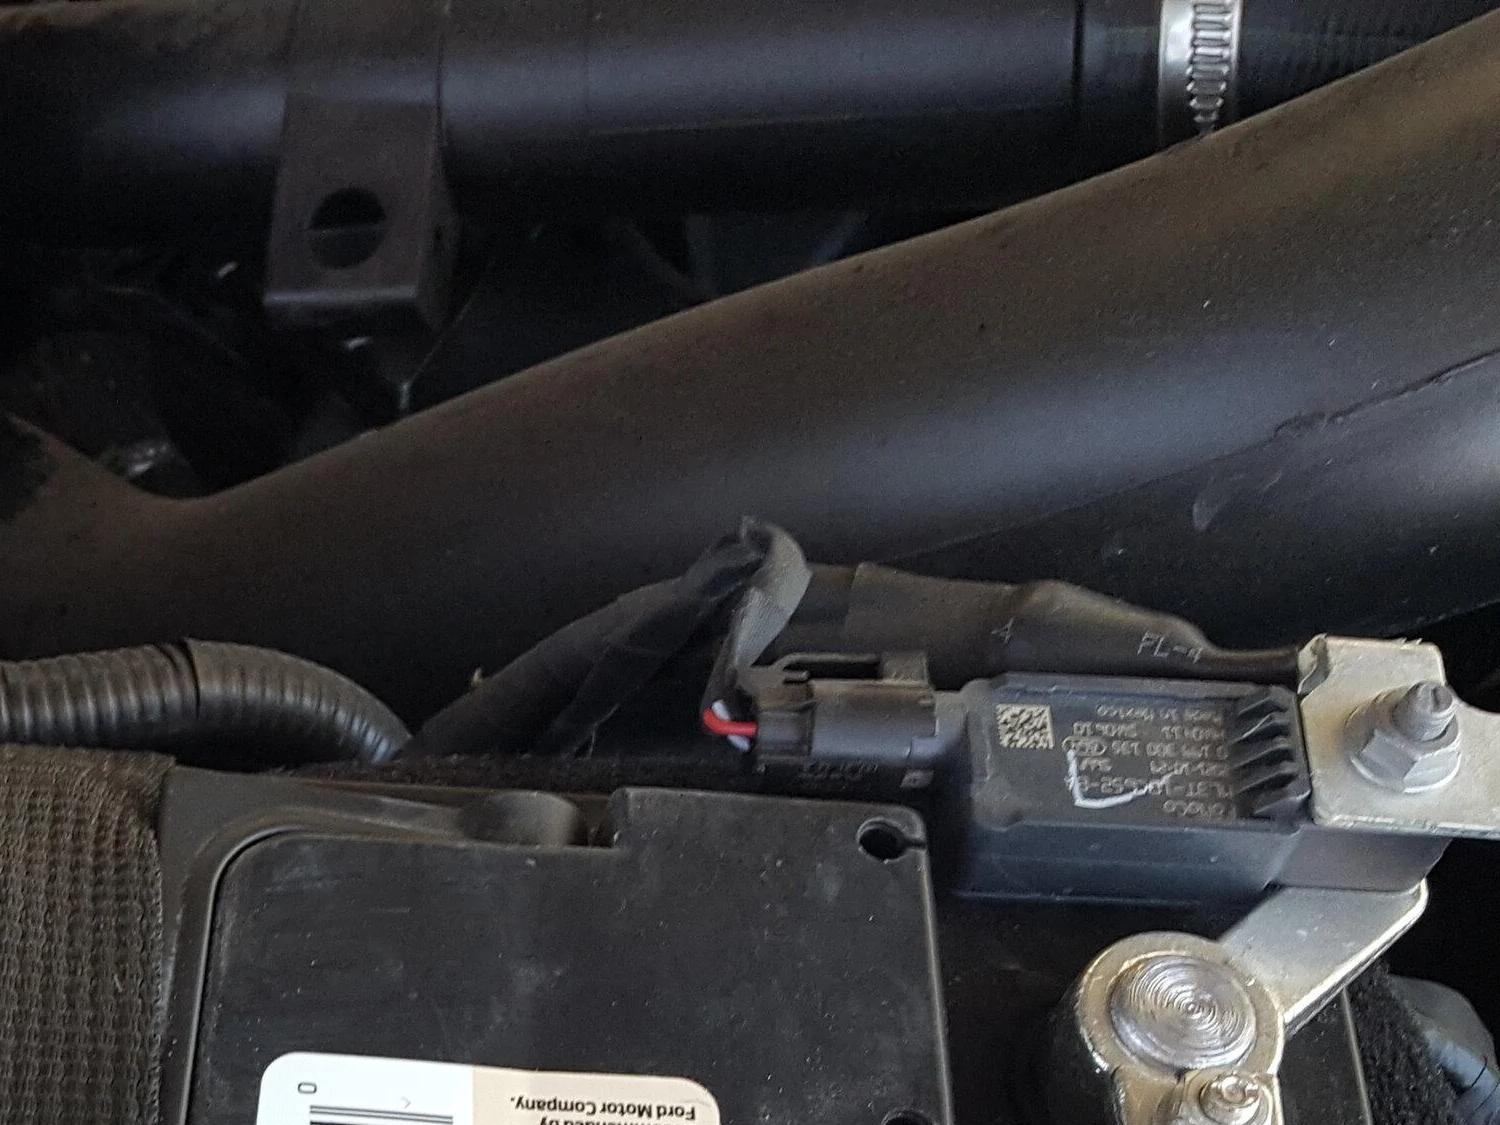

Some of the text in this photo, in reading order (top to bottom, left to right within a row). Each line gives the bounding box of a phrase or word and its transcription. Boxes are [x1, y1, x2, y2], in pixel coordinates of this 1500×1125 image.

[510, 1096, 696, 1121] Ford Motor Company.
